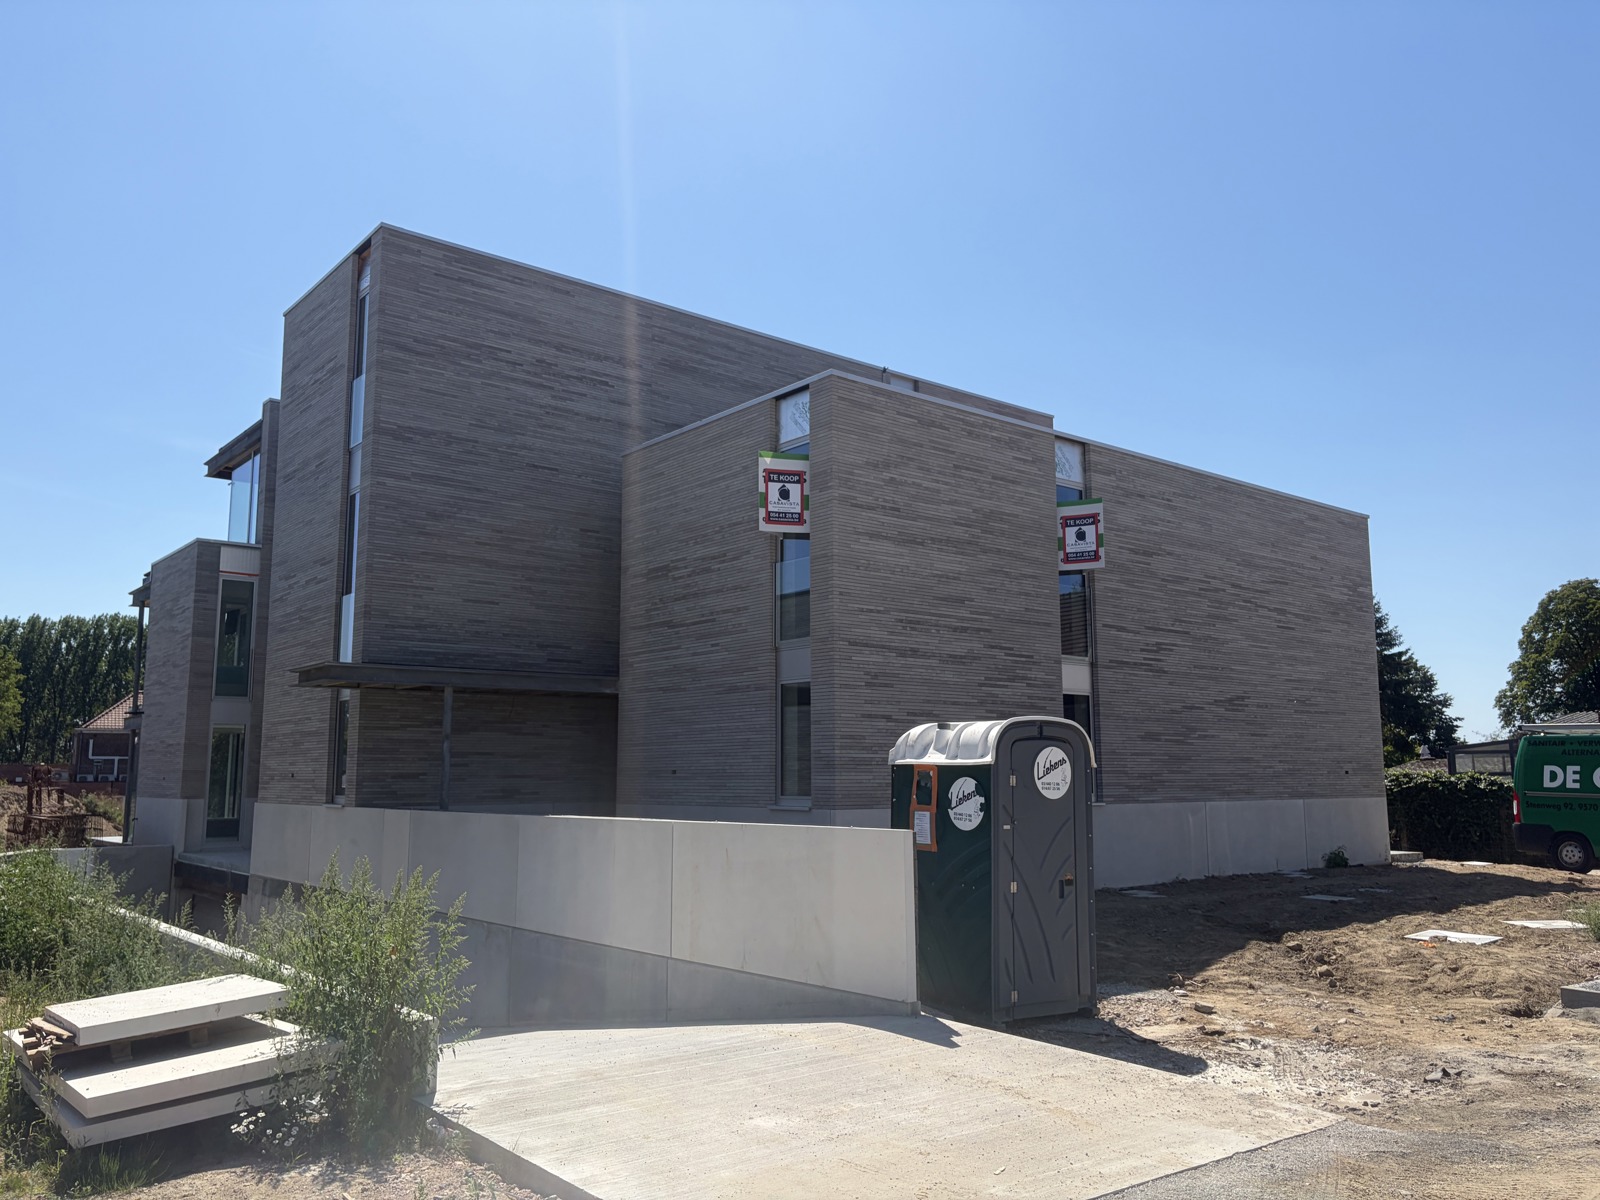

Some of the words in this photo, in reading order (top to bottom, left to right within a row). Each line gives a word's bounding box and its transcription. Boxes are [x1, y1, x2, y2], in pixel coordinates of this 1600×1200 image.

[1037, 748, 1067, 780] Liekens
[1543, 765, 1580, 789] DE
[950, 779, 977, 810] Lieken
[1526, 801, 1561, 811] Steenweg
[1578, 803, 1598, 811] 9570
